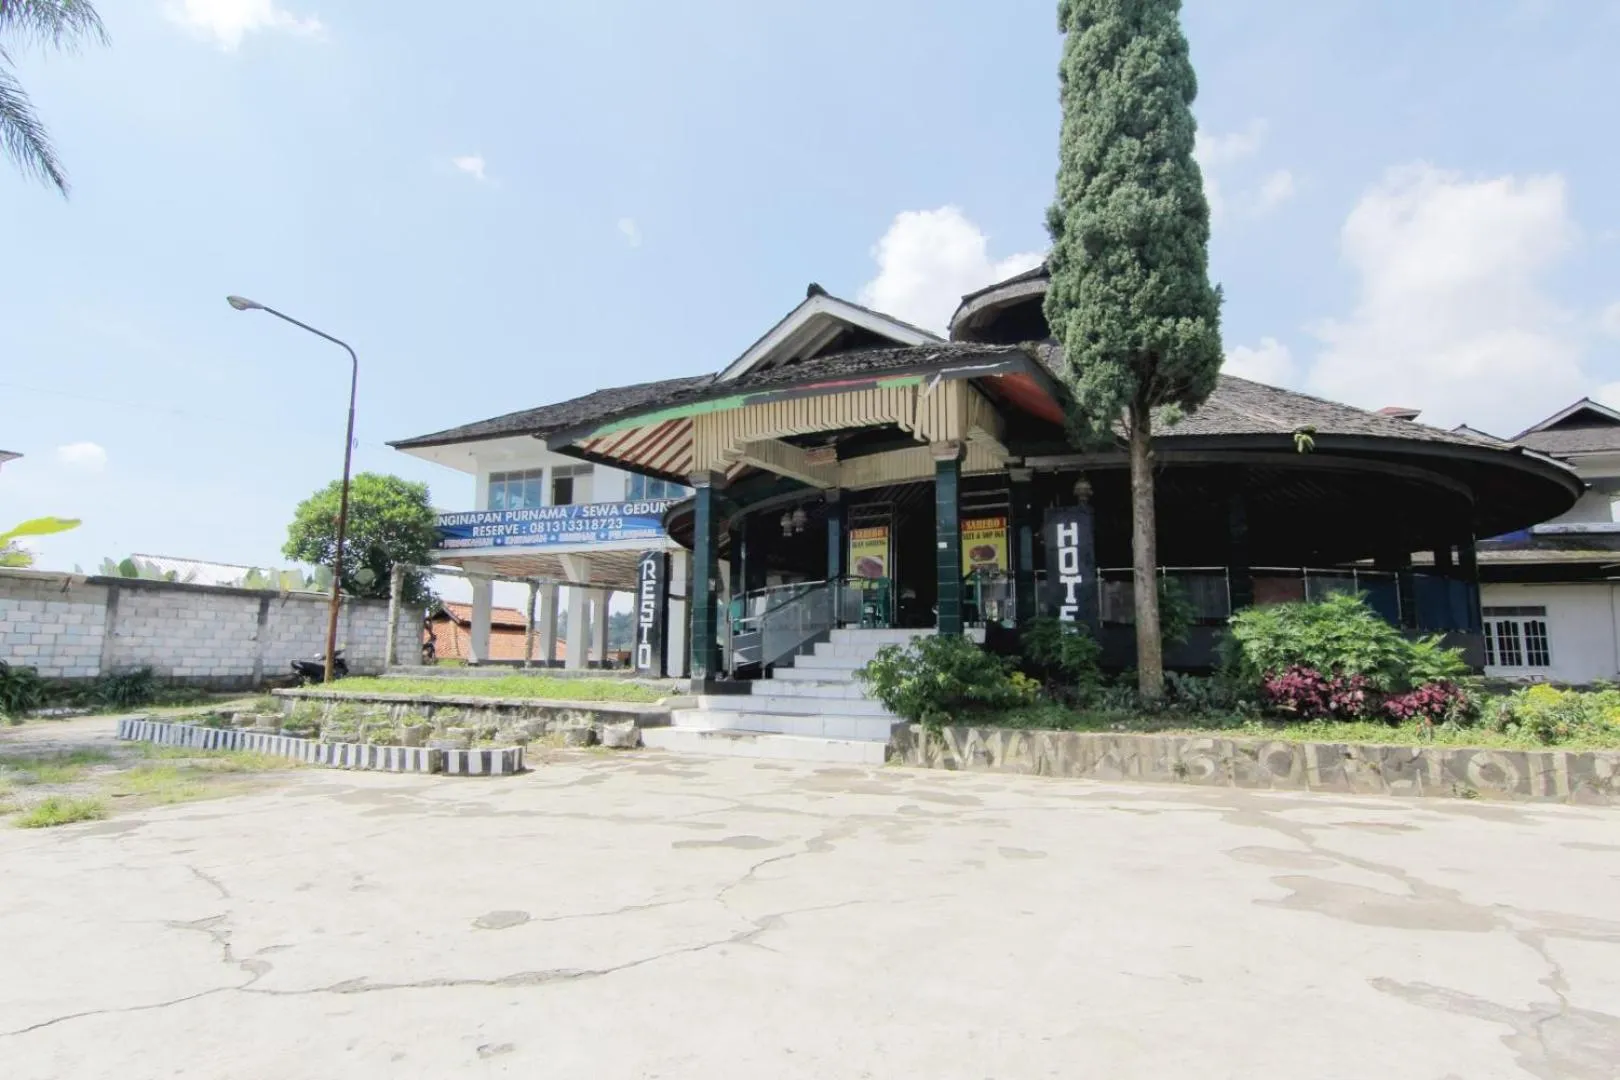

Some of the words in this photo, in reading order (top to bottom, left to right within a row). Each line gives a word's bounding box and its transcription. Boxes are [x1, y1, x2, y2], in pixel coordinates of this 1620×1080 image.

[434, 512, 502, 527] NGINAPAN
[505, 508, 568, 522] PURNAMA
[582, 504, 619, 518] SEWA
[623, 500, 671, 516] GEDUN
[472, 523, 520, 537] RESERVE
[529, 518, 623, 534] 081313318723
[1056, 522, 1082, 630] HOTE
[638, 559, 656, 669] RESTO
